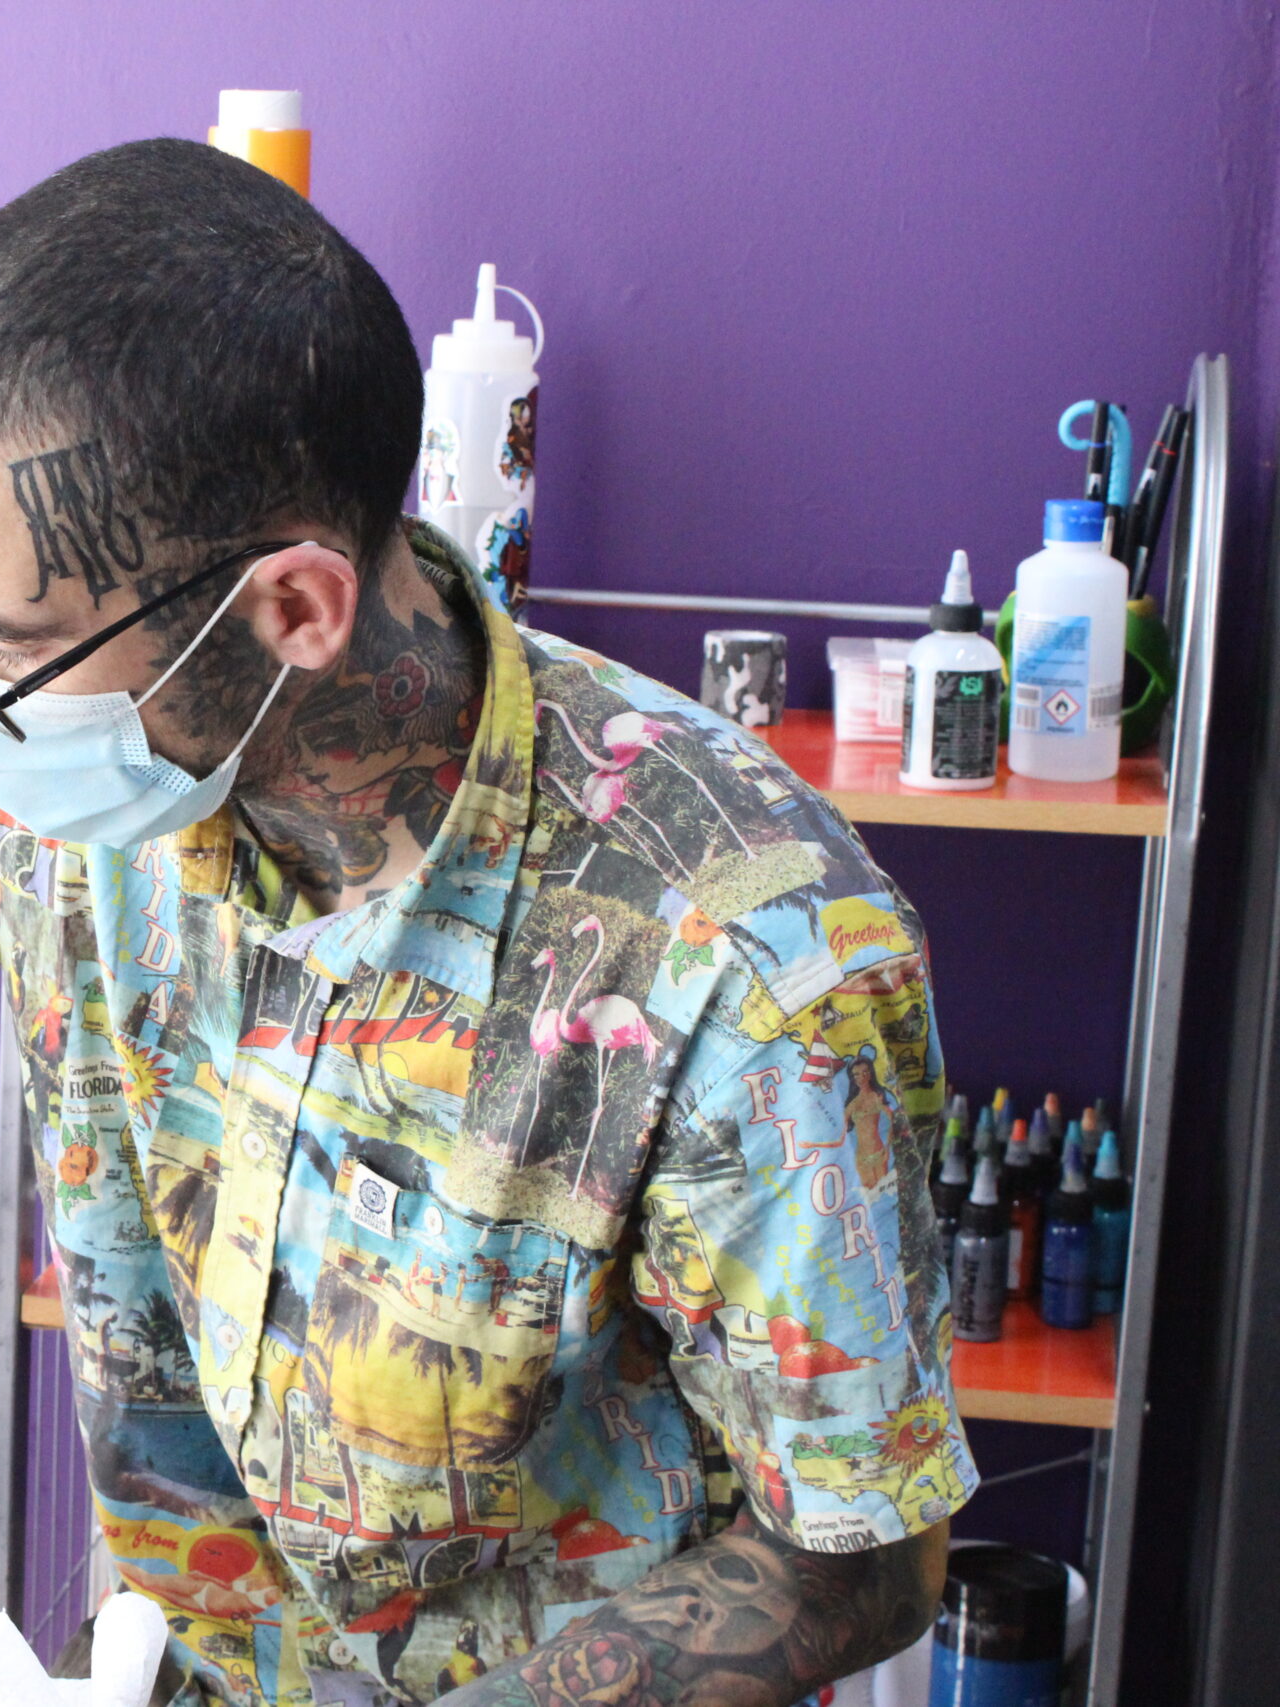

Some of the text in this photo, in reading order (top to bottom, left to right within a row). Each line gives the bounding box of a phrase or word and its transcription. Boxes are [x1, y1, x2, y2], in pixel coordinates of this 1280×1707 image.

[130, 838, 175, 1026] RIDA
[69, 1076, 125, 1099] FLORIDA
[132, 1525, 180, 1551] from
